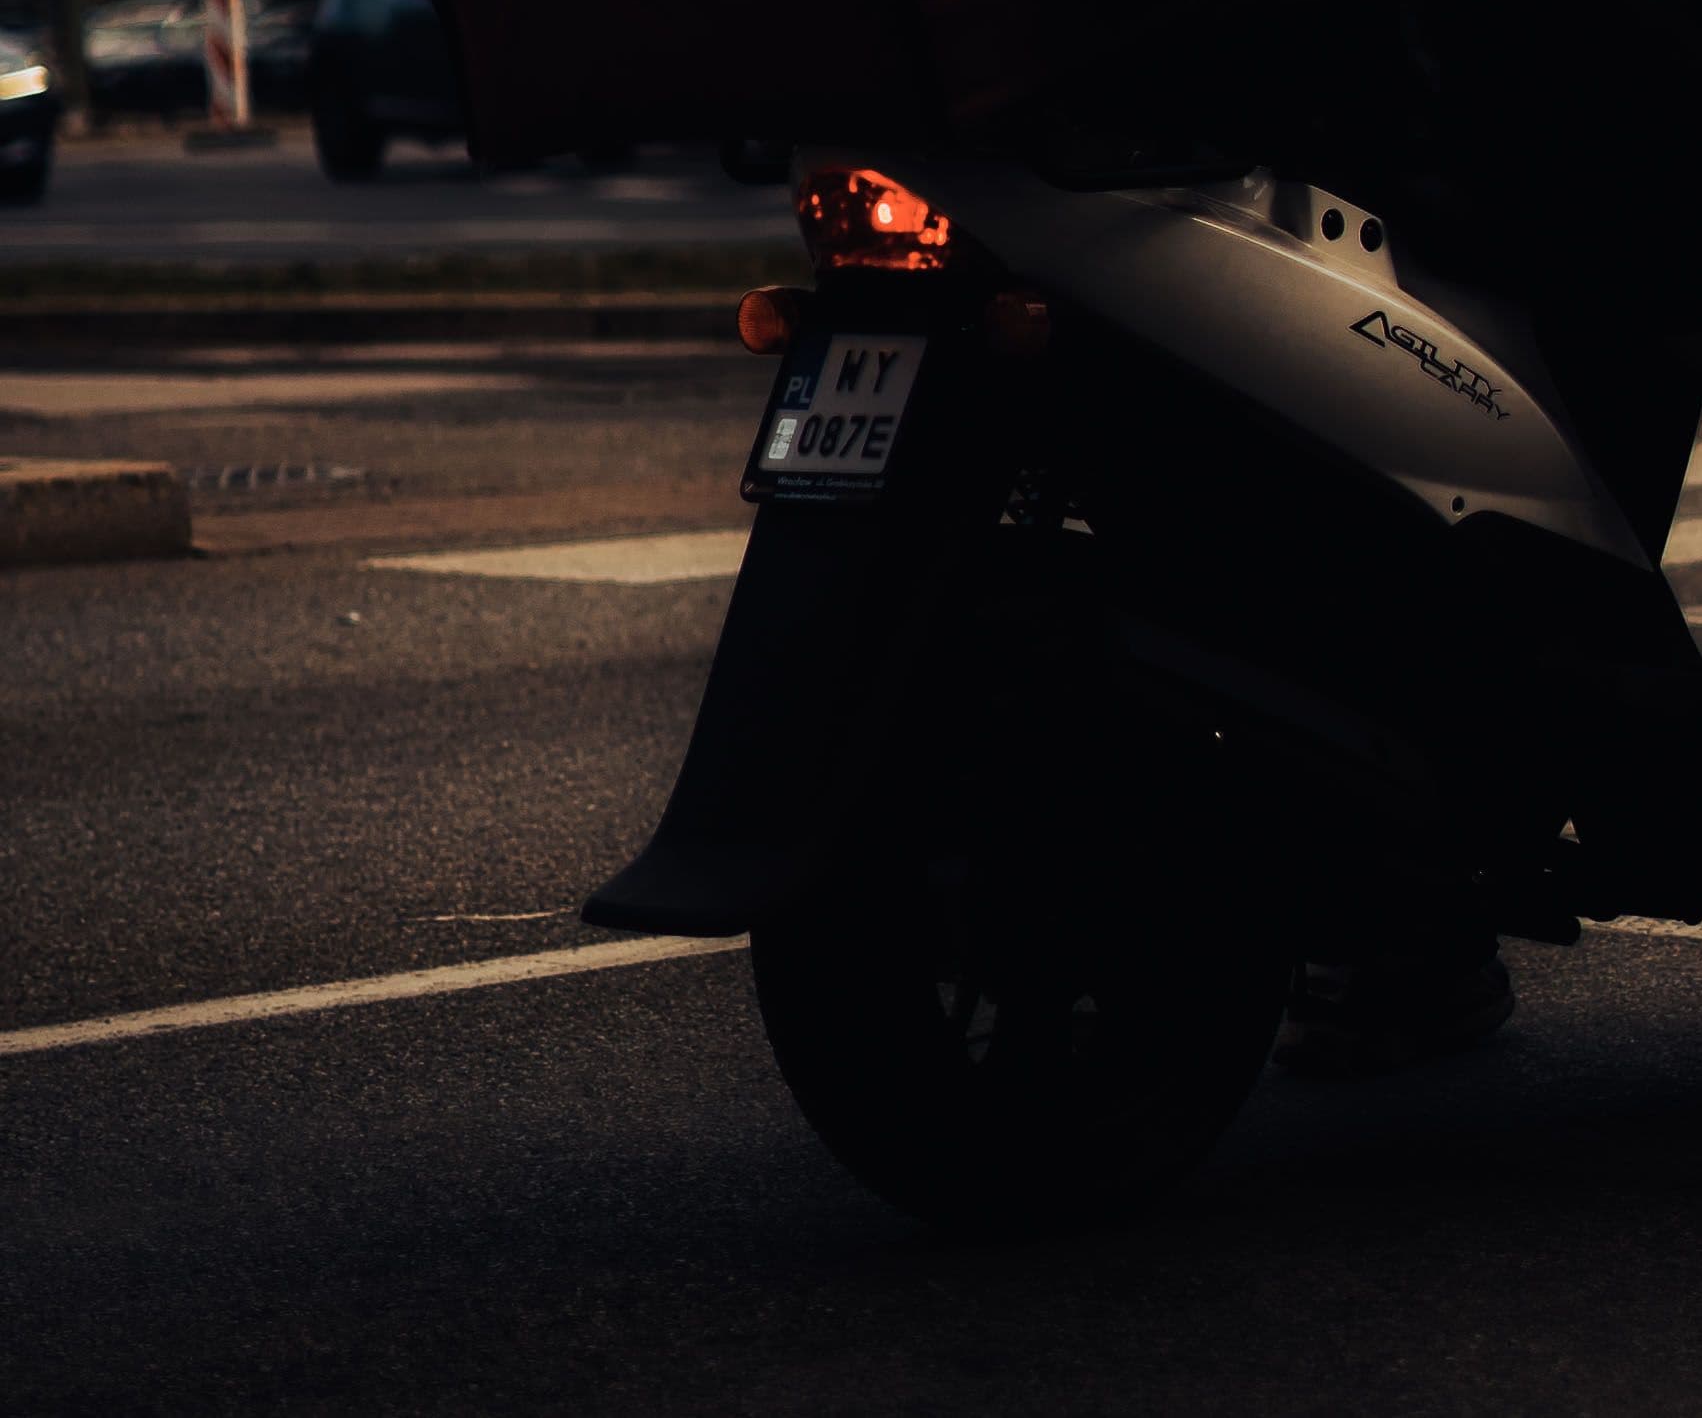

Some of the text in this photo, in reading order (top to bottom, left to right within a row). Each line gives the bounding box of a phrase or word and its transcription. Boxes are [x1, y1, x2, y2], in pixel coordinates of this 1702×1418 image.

[835, 349, 899, 393] WY
[1348, 310, 1502, 397] AGILITY
[784, 377, 812, 404] PL
[1420, 358, 1511, 420] CARRY
[797, 415, 895, 458] 087E
